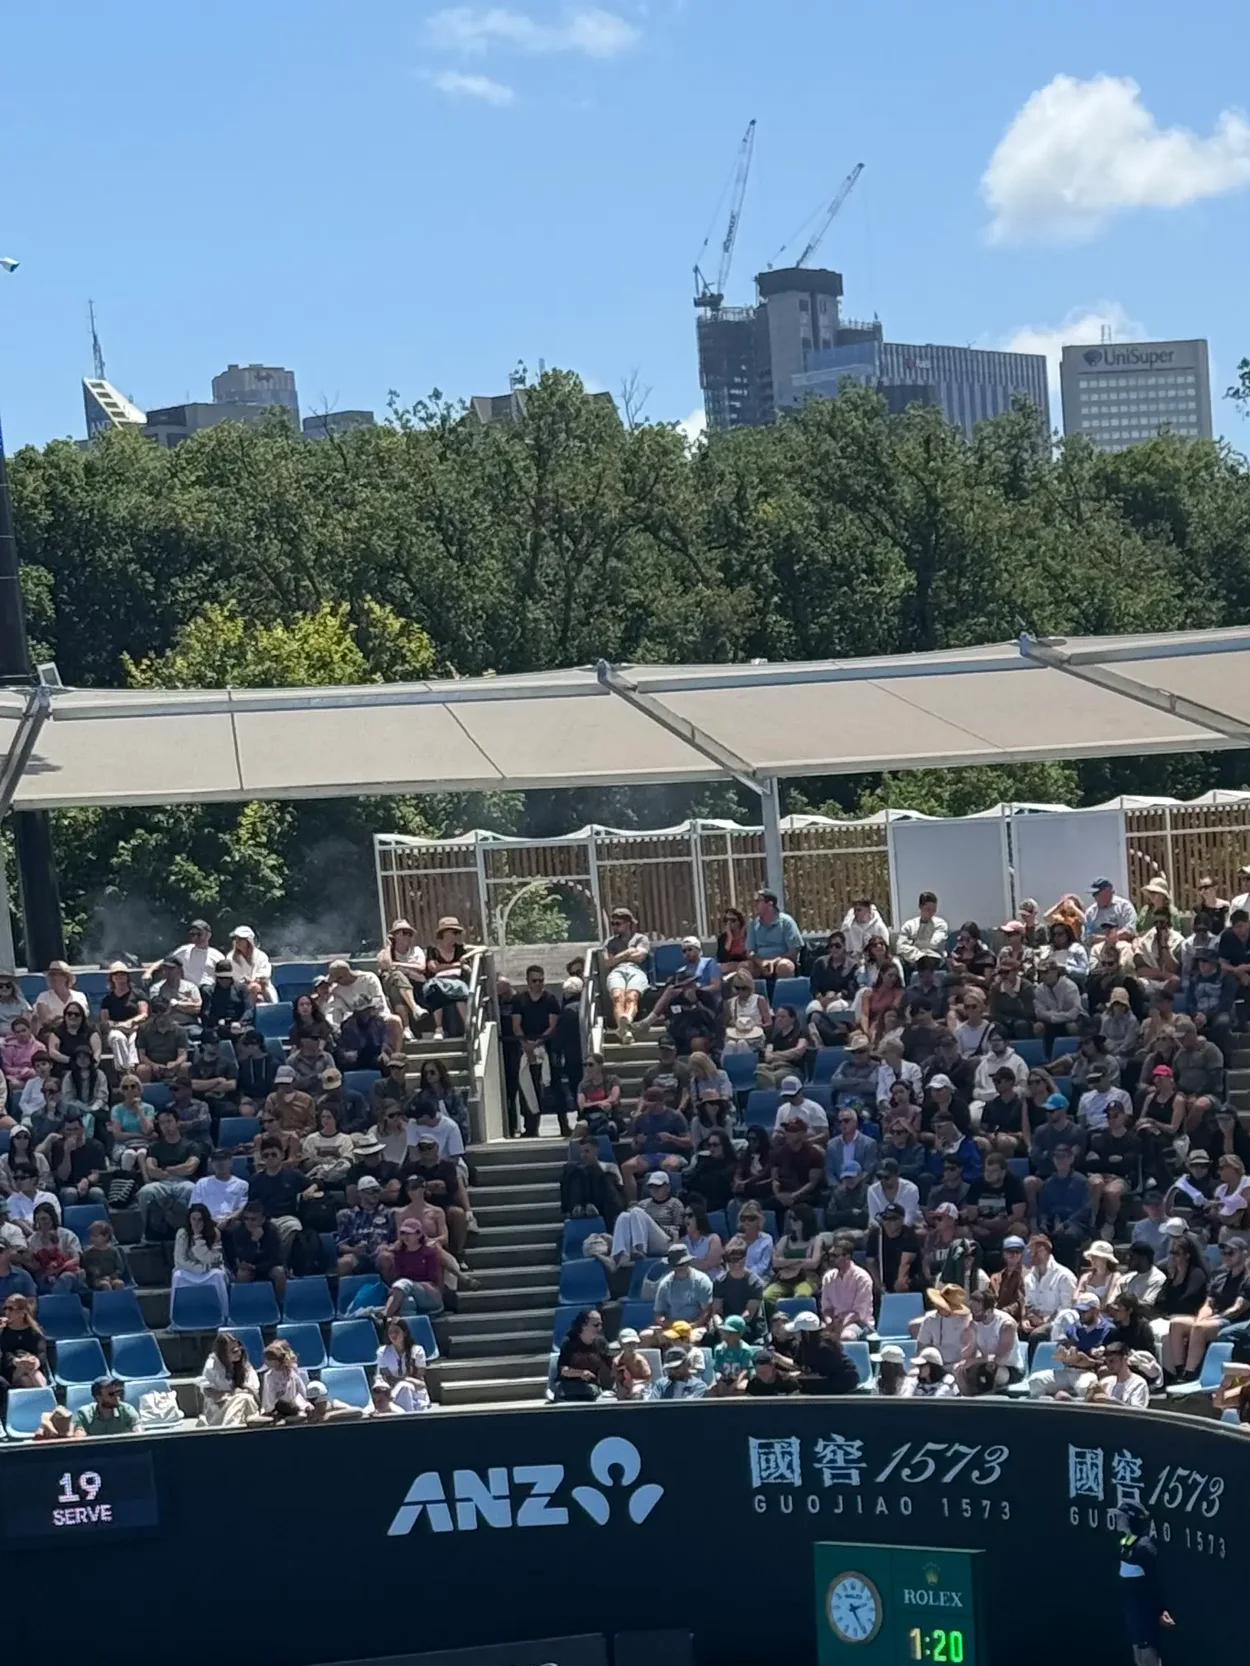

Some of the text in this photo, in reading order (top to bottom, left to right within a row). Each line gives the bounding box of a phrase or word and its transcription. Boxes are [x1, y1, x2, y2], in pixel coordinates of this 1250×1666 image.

[1104, 347, 1175, 370] UniSuper
[875, 1441, 1010, 1485] 1573
[57, 1471, 103, 1502] 19
[387, 1464, 570, 1536] ANZ
[1148, 1465, 1225, 1518] 1573
[52, 1504, 113, 1526] SERVE
[754, 1494, 1012, 1520] GUOJIAO 1573
[1069, 1506, 1226, 1559] GUOAO 1573
[903, 1588, 963, 1608] ROLEX
[909, 1627, 964, 1663] 1:20
